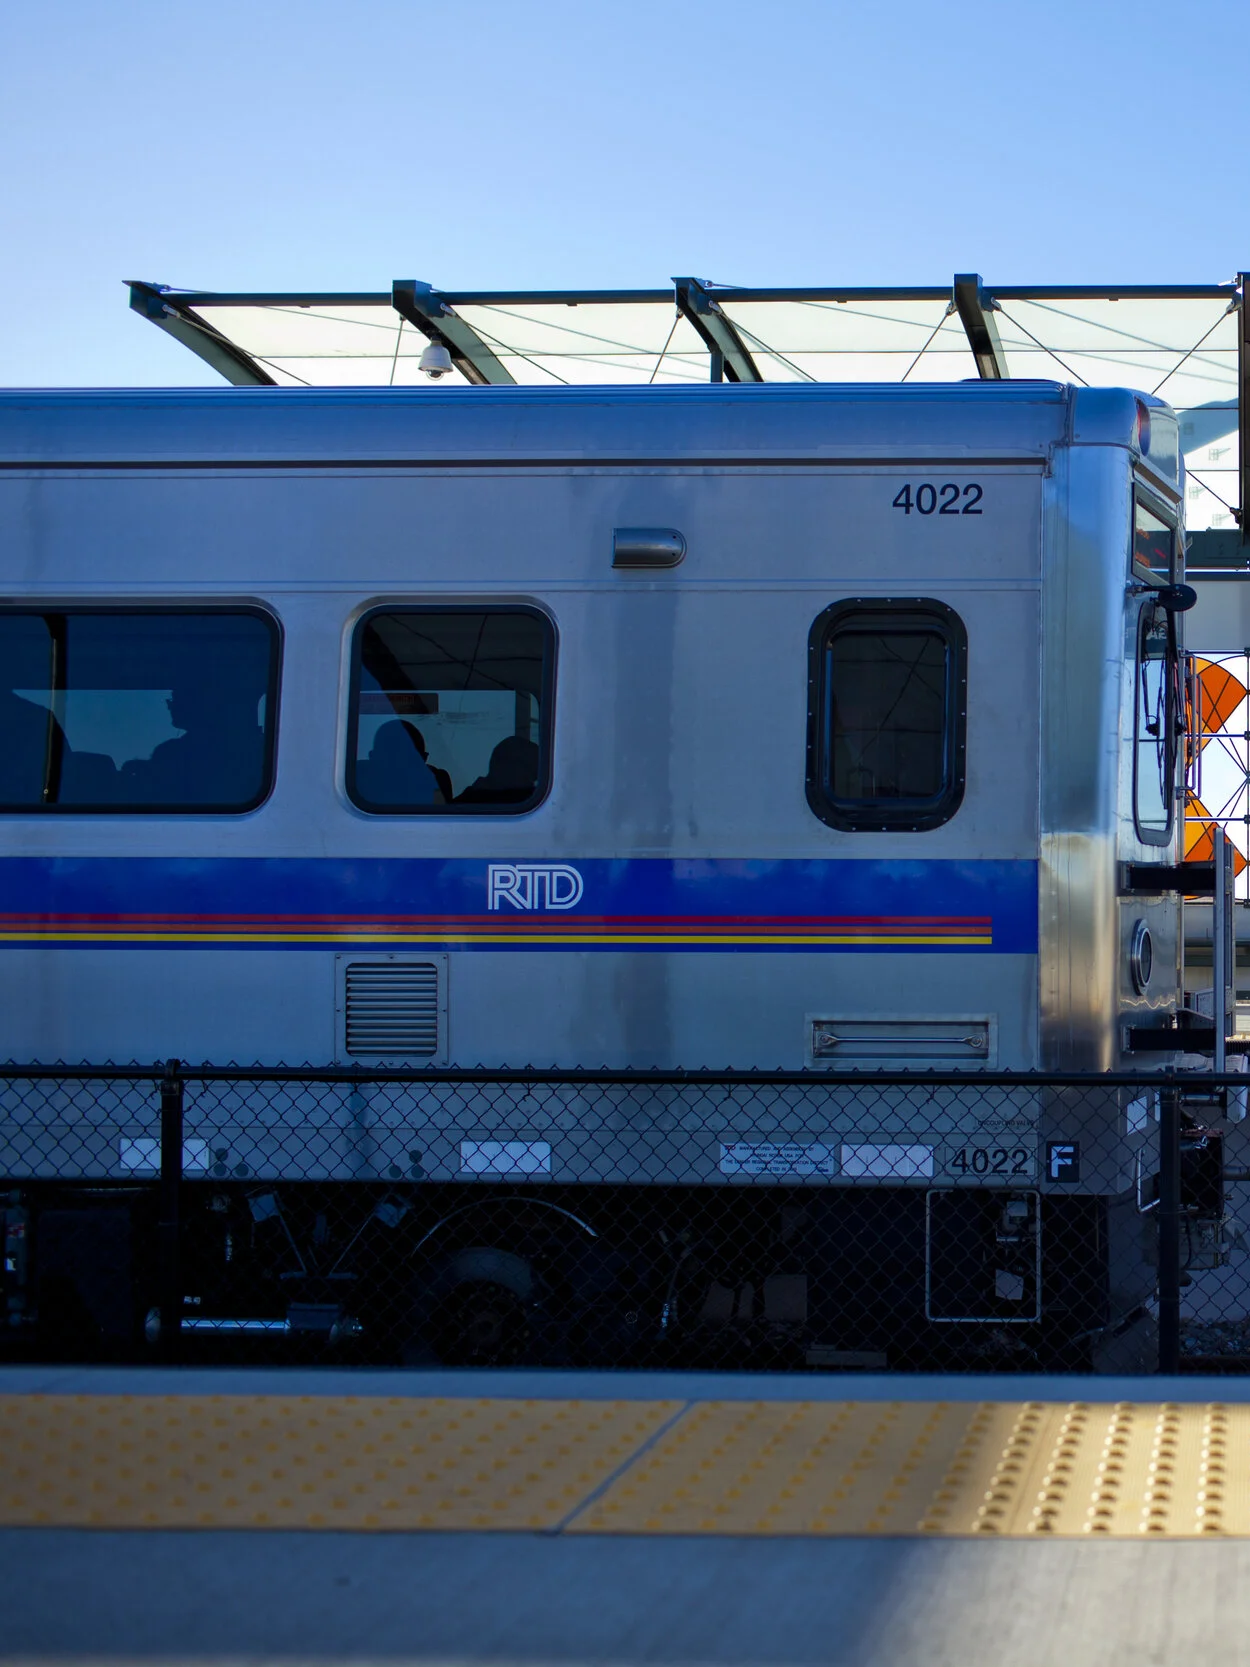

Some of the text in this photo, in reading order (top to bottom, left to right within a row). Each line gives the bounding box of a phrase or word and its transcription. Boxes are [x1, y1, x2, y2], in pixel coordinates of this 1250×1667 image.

[892, 483, 983, 515] 4022
[487, 864, 584, 910] RTD
[951, 1148, 1028, 1174] 4022
[1050, 1145, 1074, 1178] F
